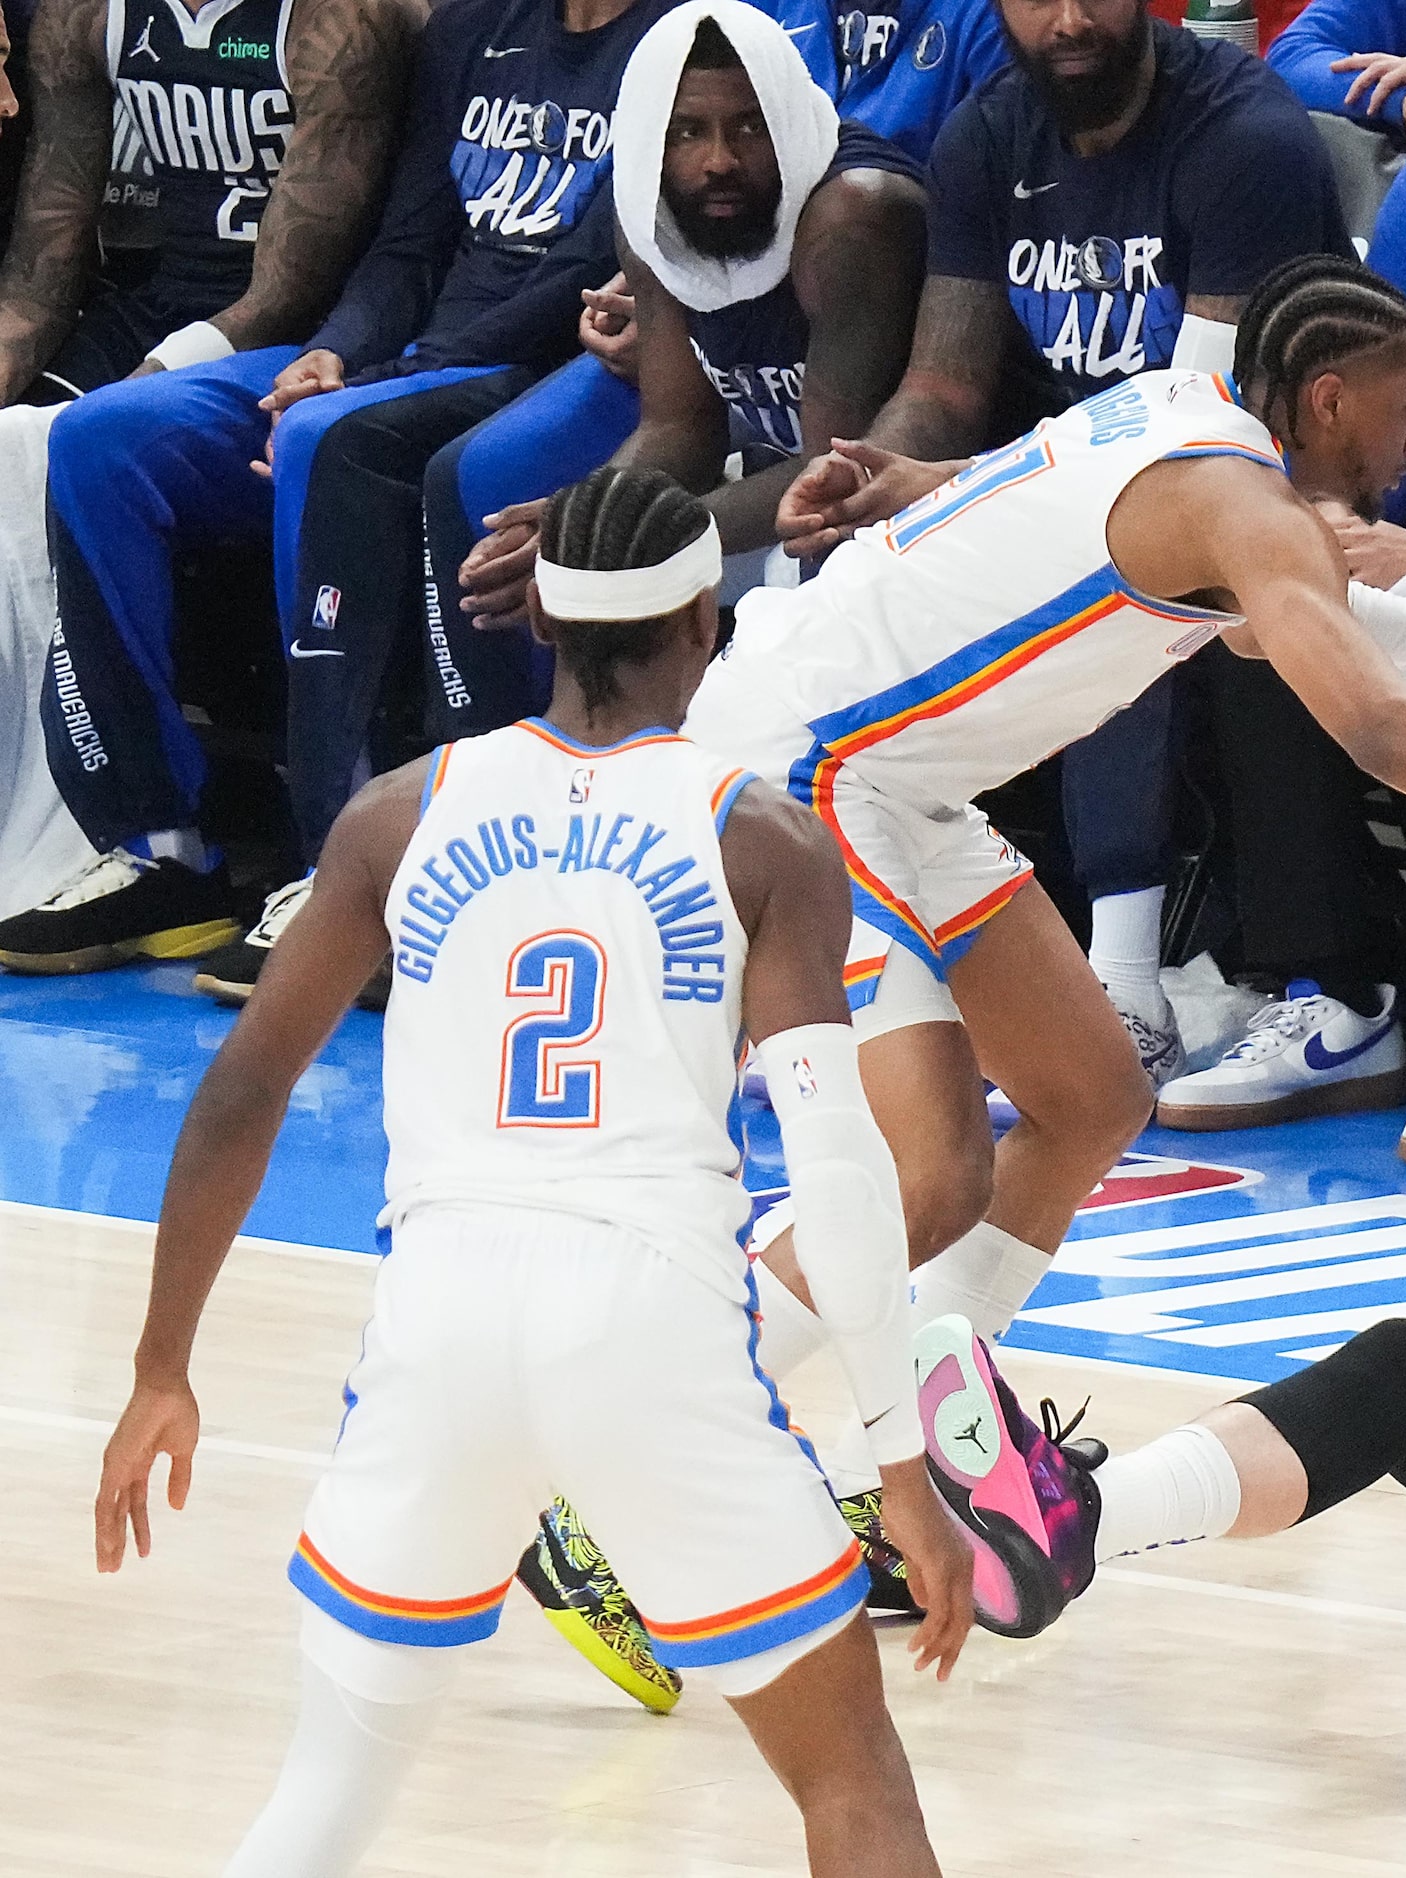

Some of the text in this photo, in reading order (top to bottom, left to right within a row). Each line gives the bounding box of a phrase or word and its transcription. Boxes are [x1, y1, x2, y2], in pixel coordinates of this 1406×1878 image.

[218, 37, 270, 60] chime
[461, 93, 532, 151] ONE
[465, 150, 563, 236] ALL
[1008, 233, 1082, 293] ONE
[1042, 291, 1146, 378] ALL
[395, 812, 727, 1005] GILGEOUS-ALEXANDER
[495, 927, 609, 1130] 2
